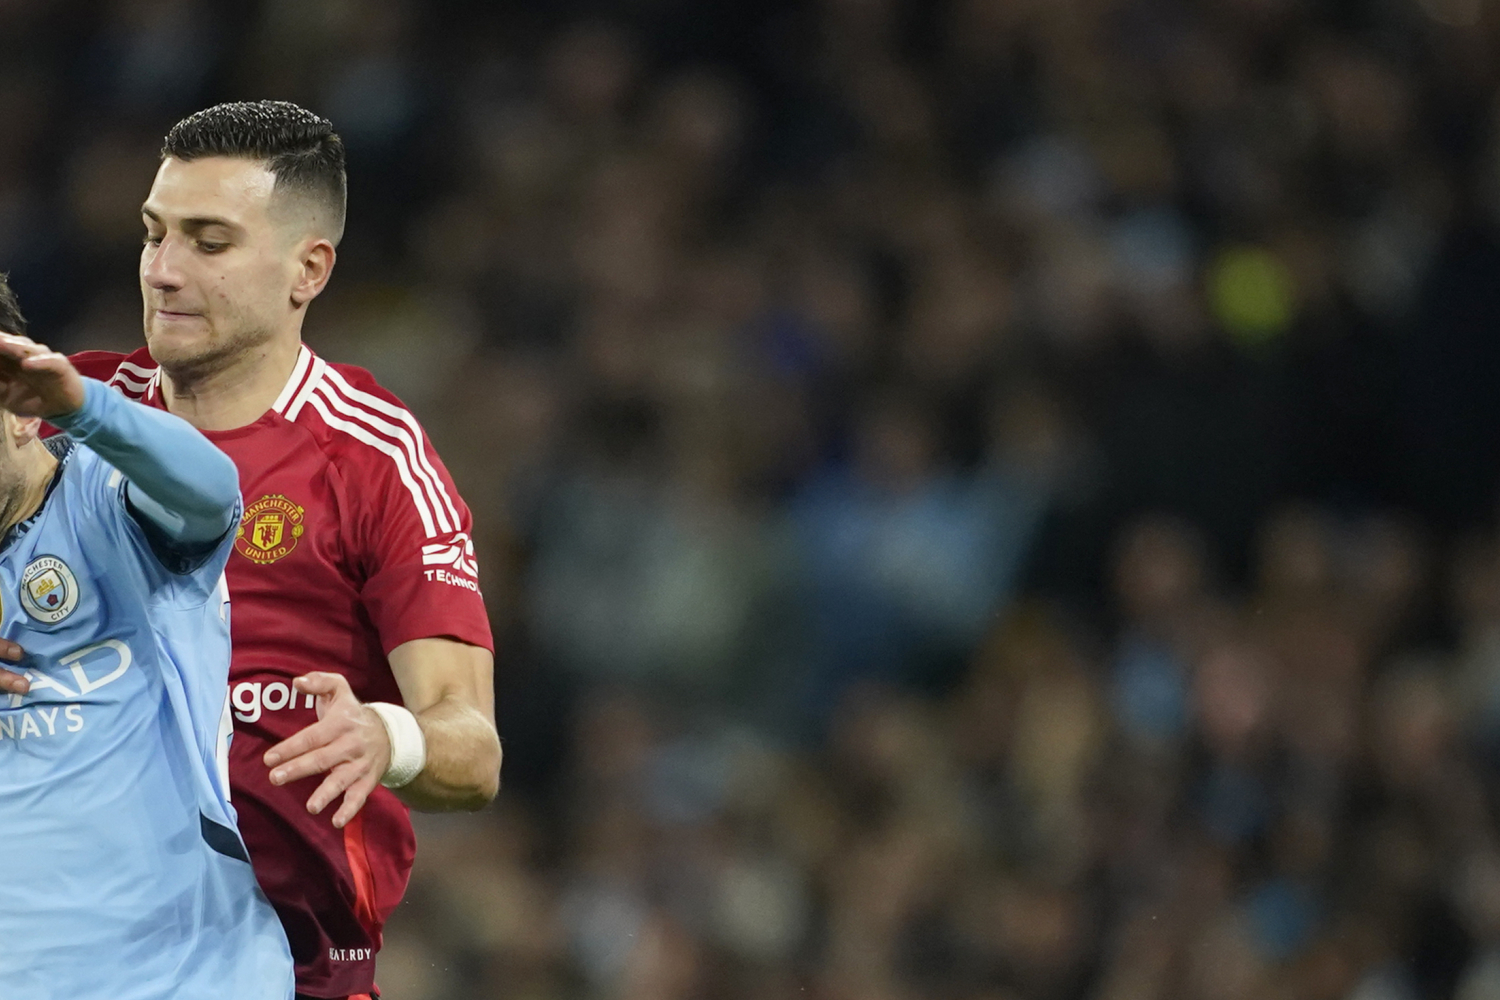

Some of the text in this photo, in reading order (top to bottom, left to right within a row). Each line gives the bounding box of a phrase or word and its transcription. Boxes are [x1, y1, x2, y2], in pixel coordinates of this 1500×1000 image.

[242, 500, 299, 521] MANCHESTER
[245, 547, 286, 559] UNITED
[424, 569, 478, 593] TECHNO
[51, 606, 69, 620] CITY
